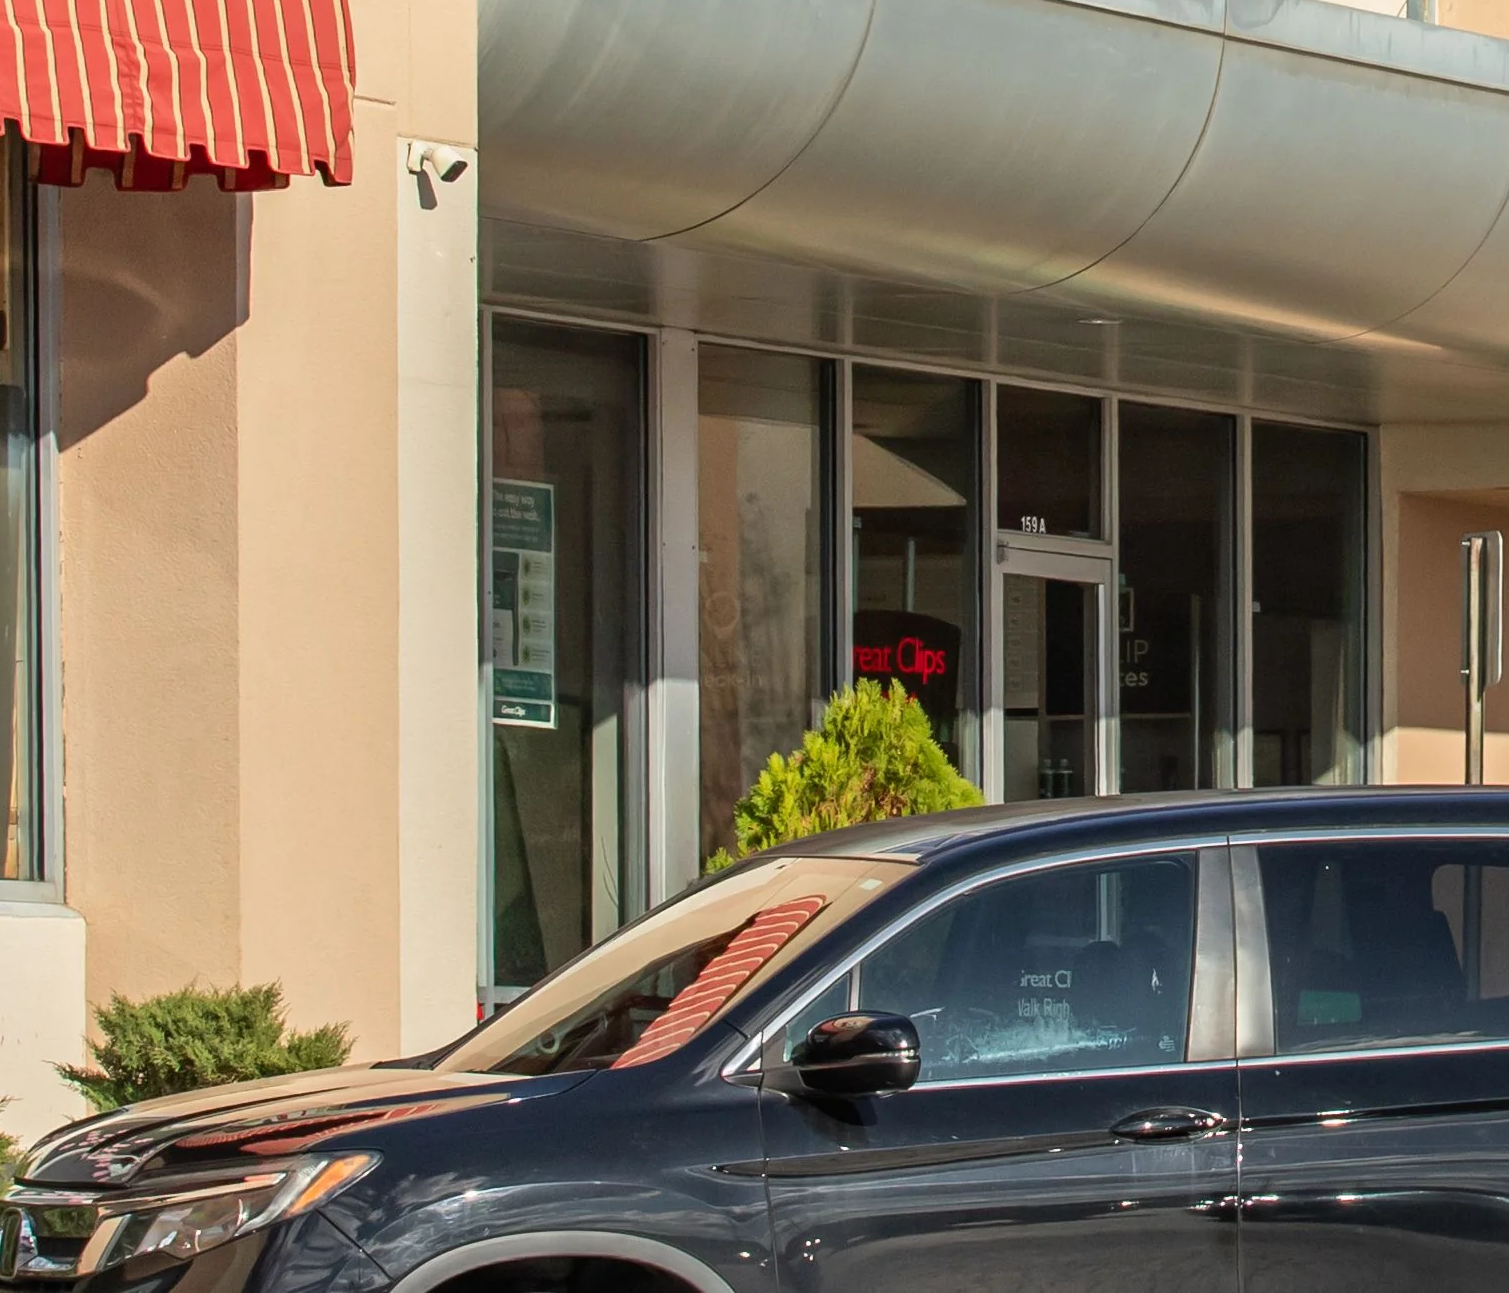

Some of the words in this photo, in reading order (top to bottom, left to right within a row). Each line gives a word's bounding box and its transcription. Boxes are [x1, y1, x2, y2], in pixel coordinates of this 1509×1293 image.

[853, 646, 892, 672] reat
[896, 637, 947, 685] Clips
[1043, 997, 1073, 1021] Righ
